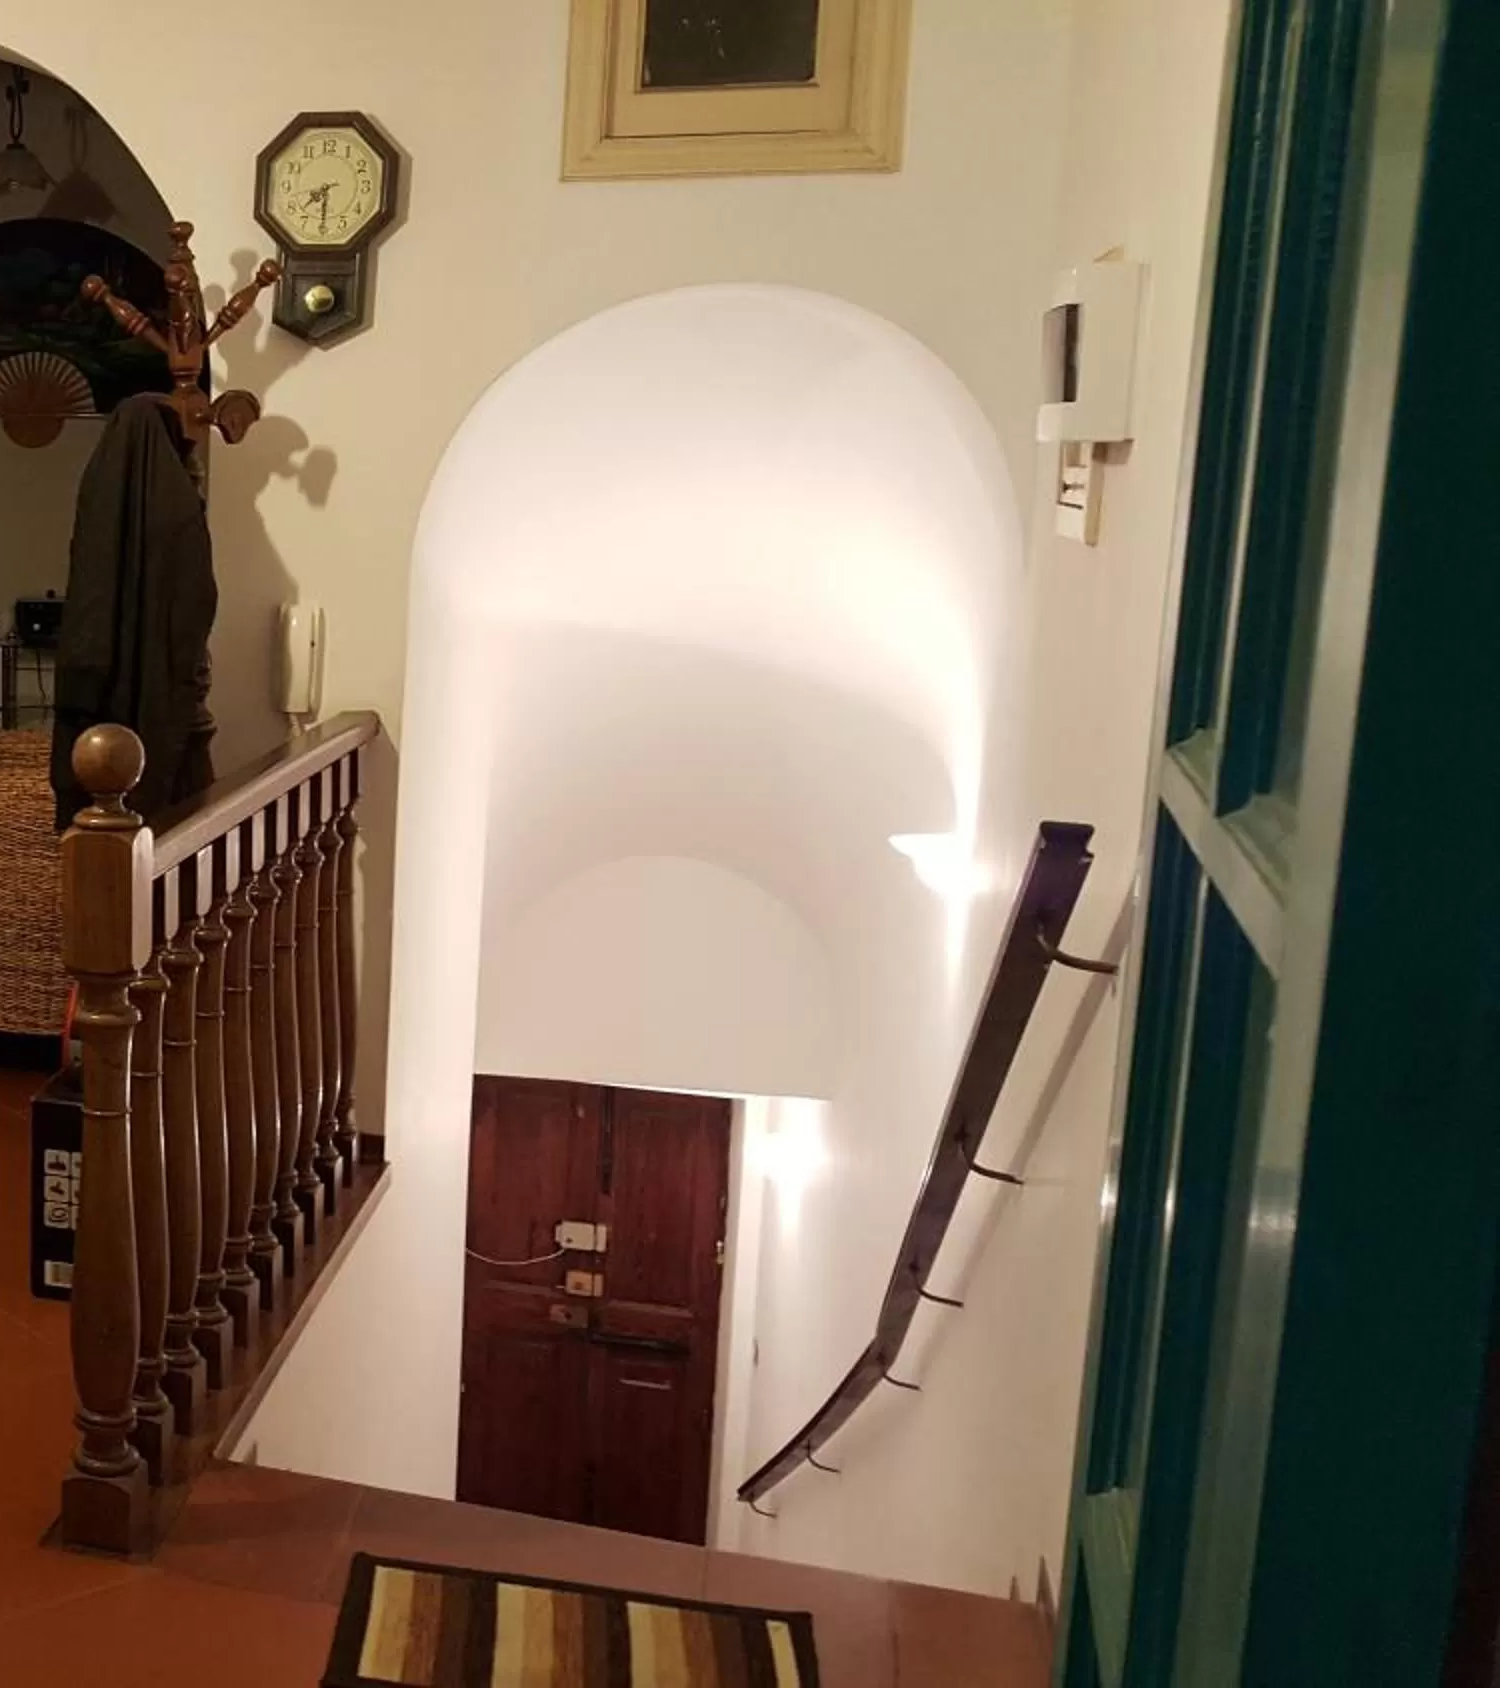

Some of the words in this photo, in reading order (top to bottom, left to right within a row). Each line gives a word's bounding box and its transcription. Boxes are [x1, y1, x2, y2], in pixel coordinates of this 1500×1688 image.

[302, 145, 315, 159] 11
[323, 139, 337, 154] 12
[344, 144, 351, 159] 1
[356, 159, 367, 175] 2
[281, 180, 292, 194] 9
[360, 179, 371, 194] 3
[286, 200, 297, 216] 8
[352, 200, 362, 215] 4
[299, 215, 309, 232] 7
[337, 215, 348, 230] 5
